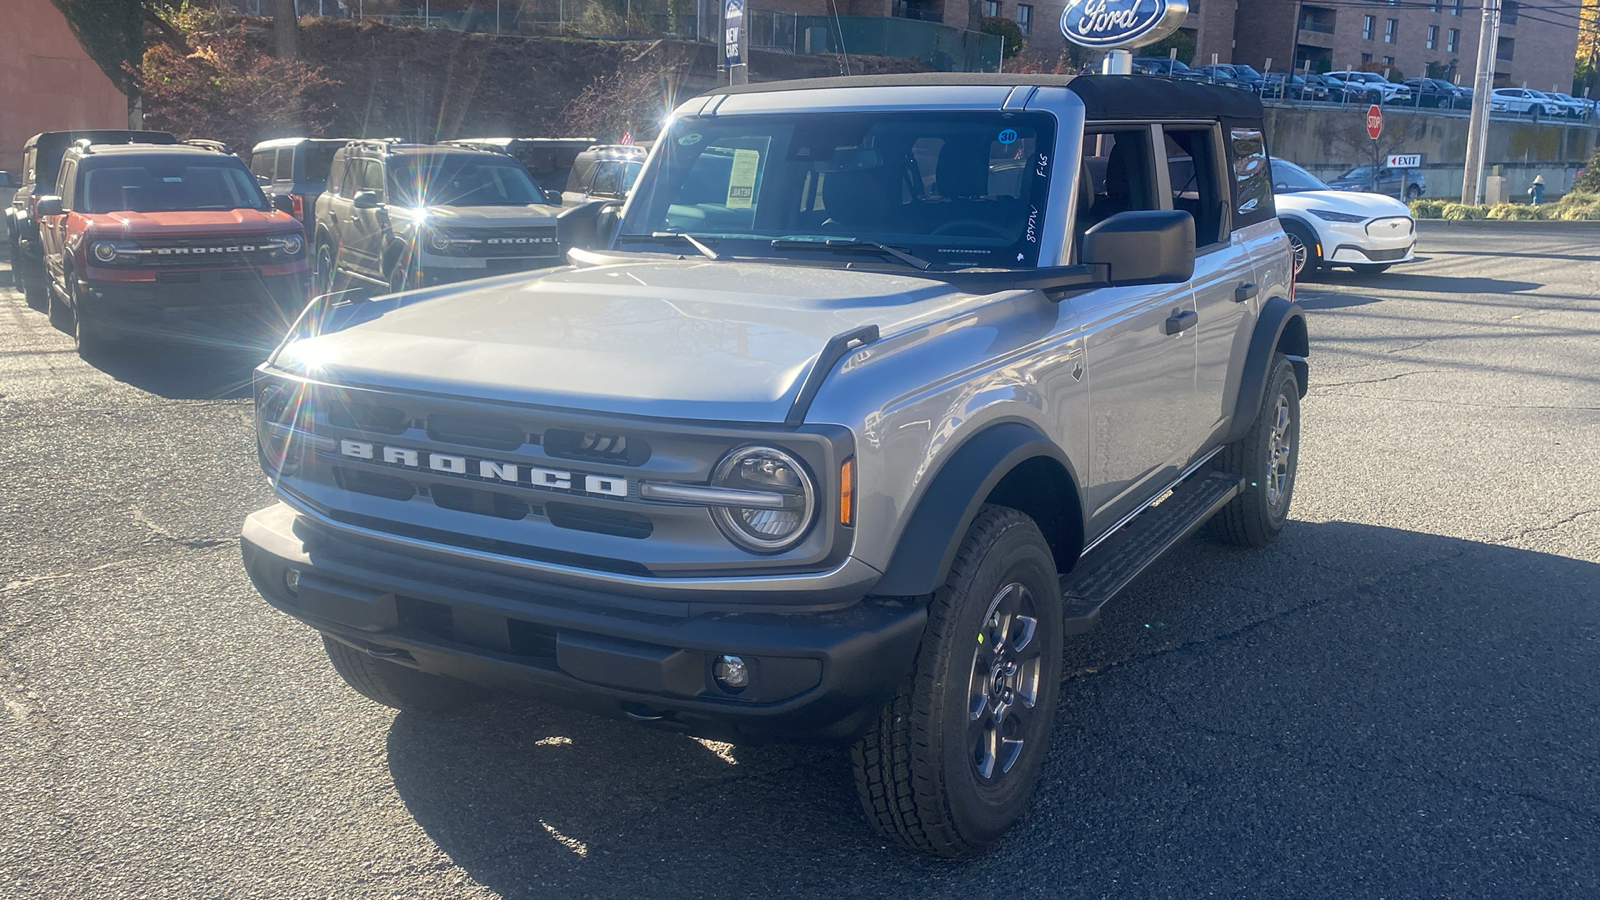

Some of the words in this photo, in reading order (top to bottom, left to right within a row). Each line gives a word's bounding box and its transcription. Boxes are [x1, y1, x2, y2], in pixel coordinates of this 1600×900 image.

[1078, 0, 1139, 35] Ford
[725, 27, 738, 44] NEW
[726, 43, 738, 58] CARS
[1368, 115, 1380, 128] STOP
[1001, 131, 1015, 141] 30
[1398, 156, 1417, 166] EXIT
[157, 245, 256, 255] BRONCO
[341, 438, 628, 498] BRONCO
